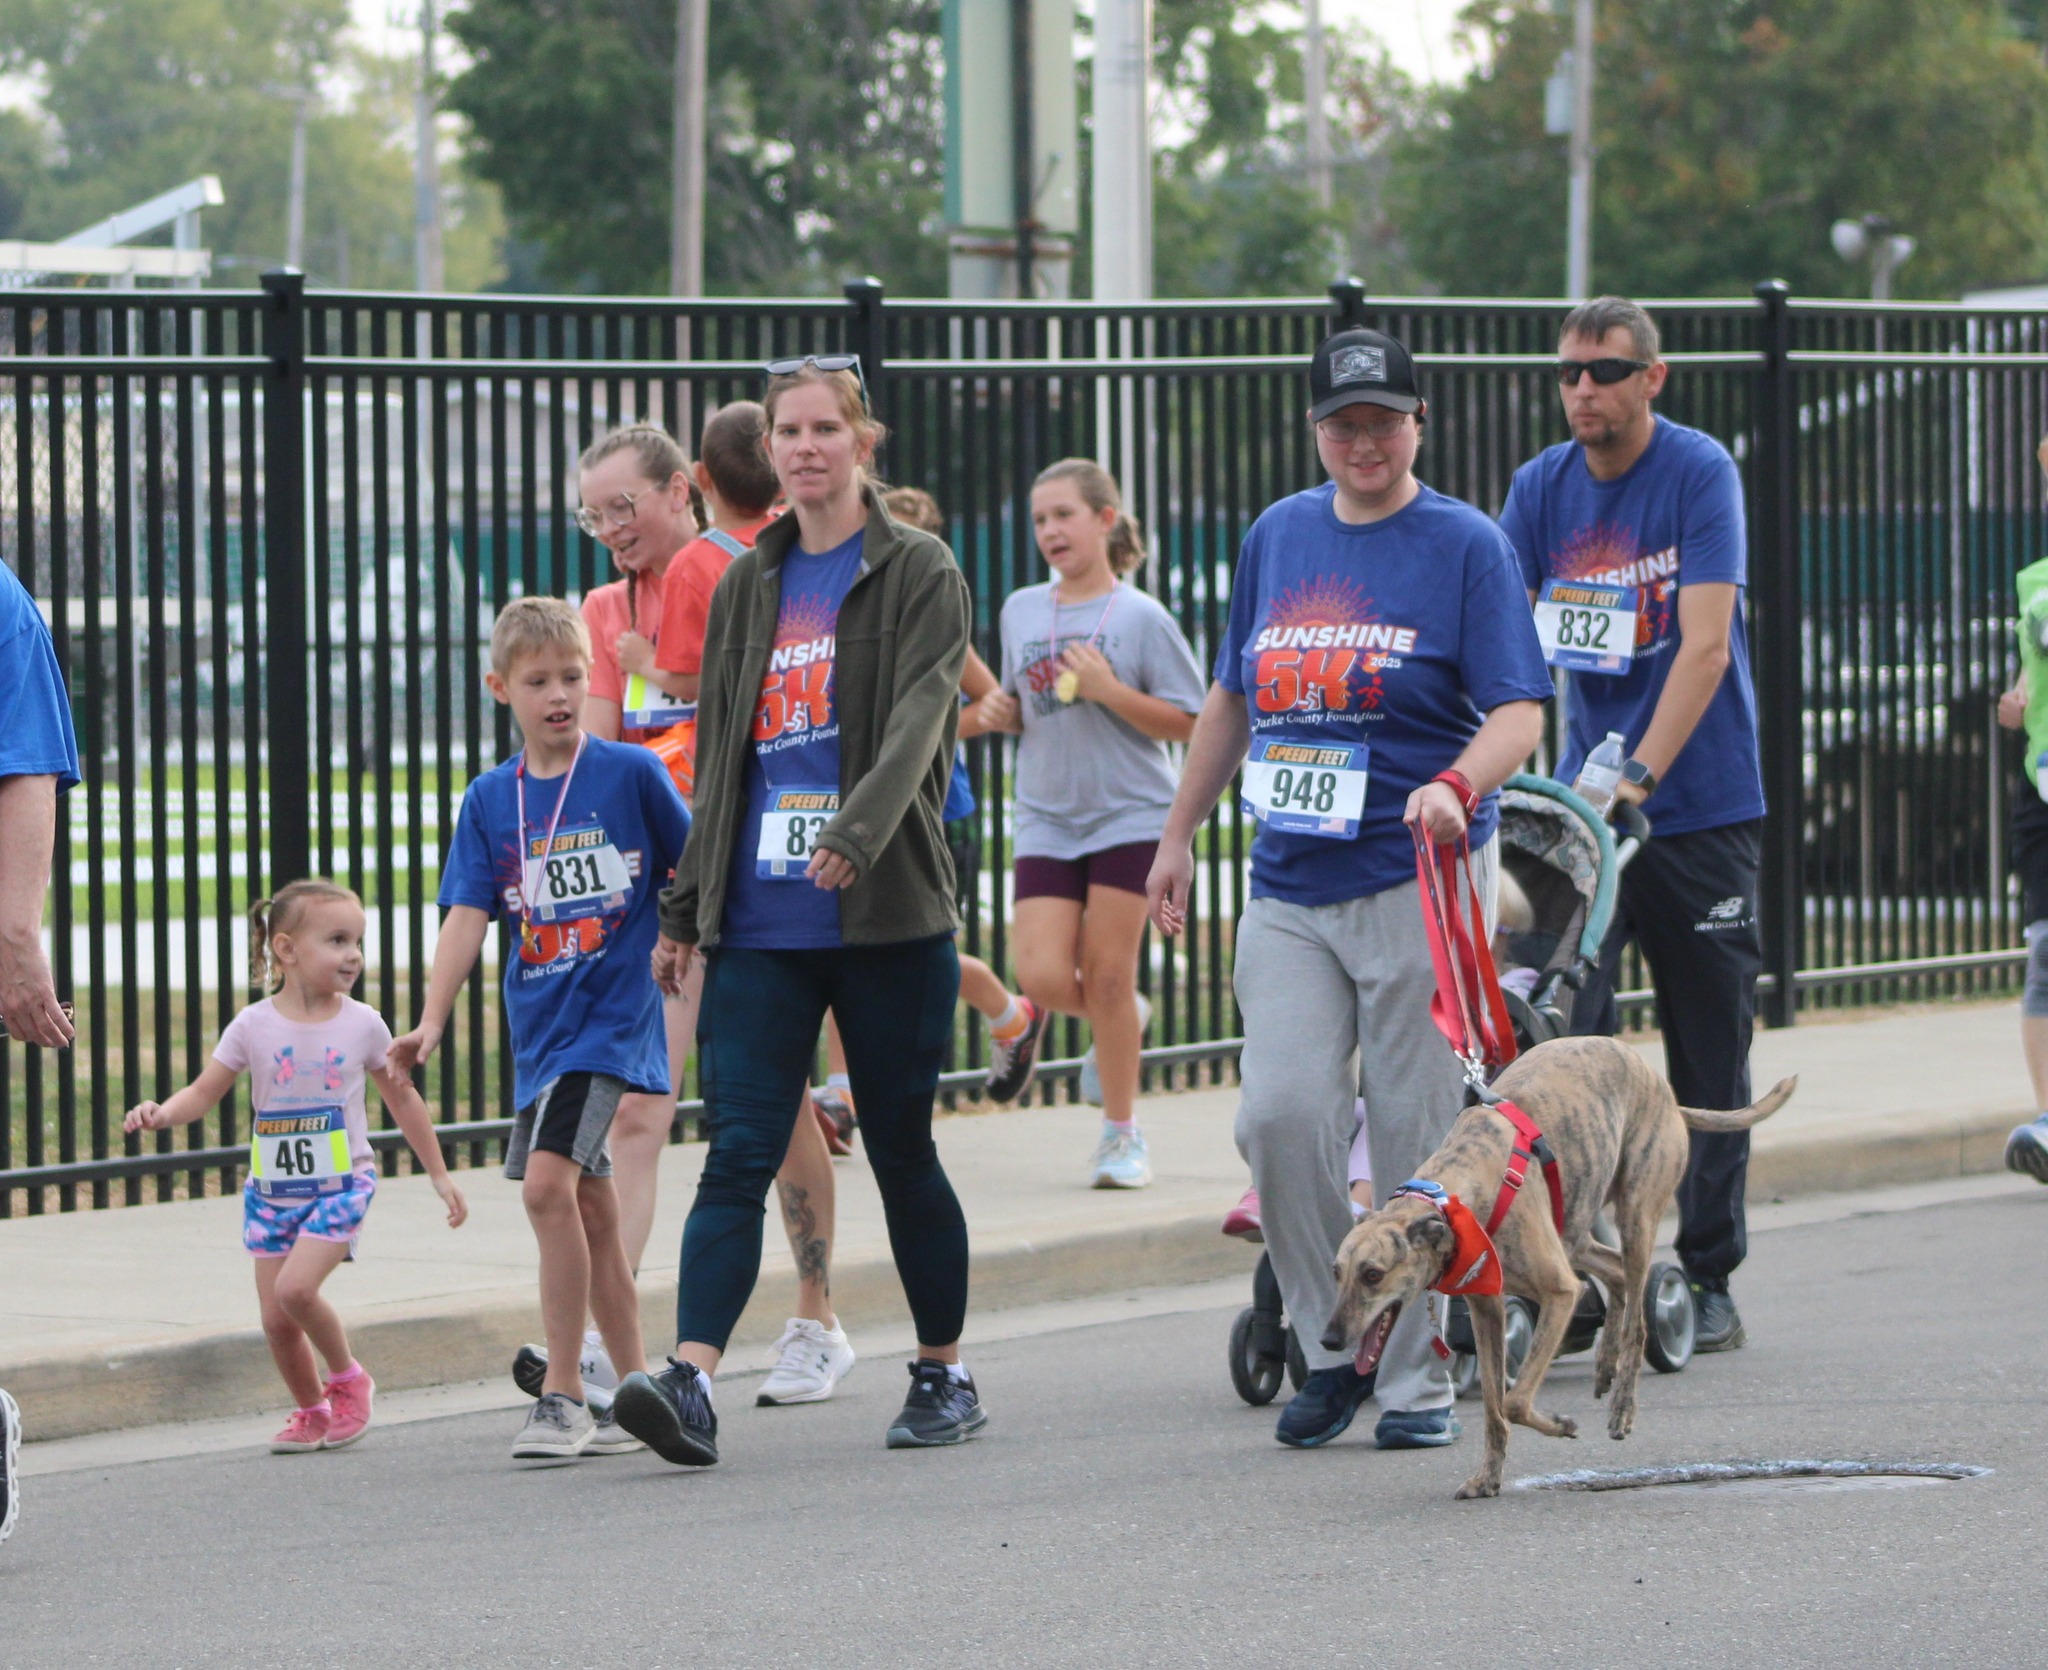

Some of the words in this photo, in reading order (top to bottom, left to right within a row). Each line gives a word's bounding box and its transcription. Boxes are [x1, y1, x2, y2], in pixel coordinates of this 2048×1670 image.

[1551, 587, 1591, 603] SPEEDY
[1593, 593, 1620, 606] FEET
[1254, 626, 1416, 652] SUNSHINE
[1557, 609, 1609, 650] 832
[1369, 656, 1401, 668] 2025
[1256, 650, 1356, 712] 5K
[754, 662, 832, 740] 5K
[1286, 712, 1323, 726] County
[774, 732, 809, 752] County
[1266, 745, 1317, 763] SPEEDY
[1317, 750, 1350, 766] FEET
[1270, 768, 1336, 812] 948
[779, 794, 828, 809] SPEEDY
[578, 830, 604, 846] FEET
[546, 853, 606, 899] 831
[258, 1120, 298, 1134] SPEEDY
[299, 1117, 328, 1131] FEET
[275, 1138, 315, 1176] 46
